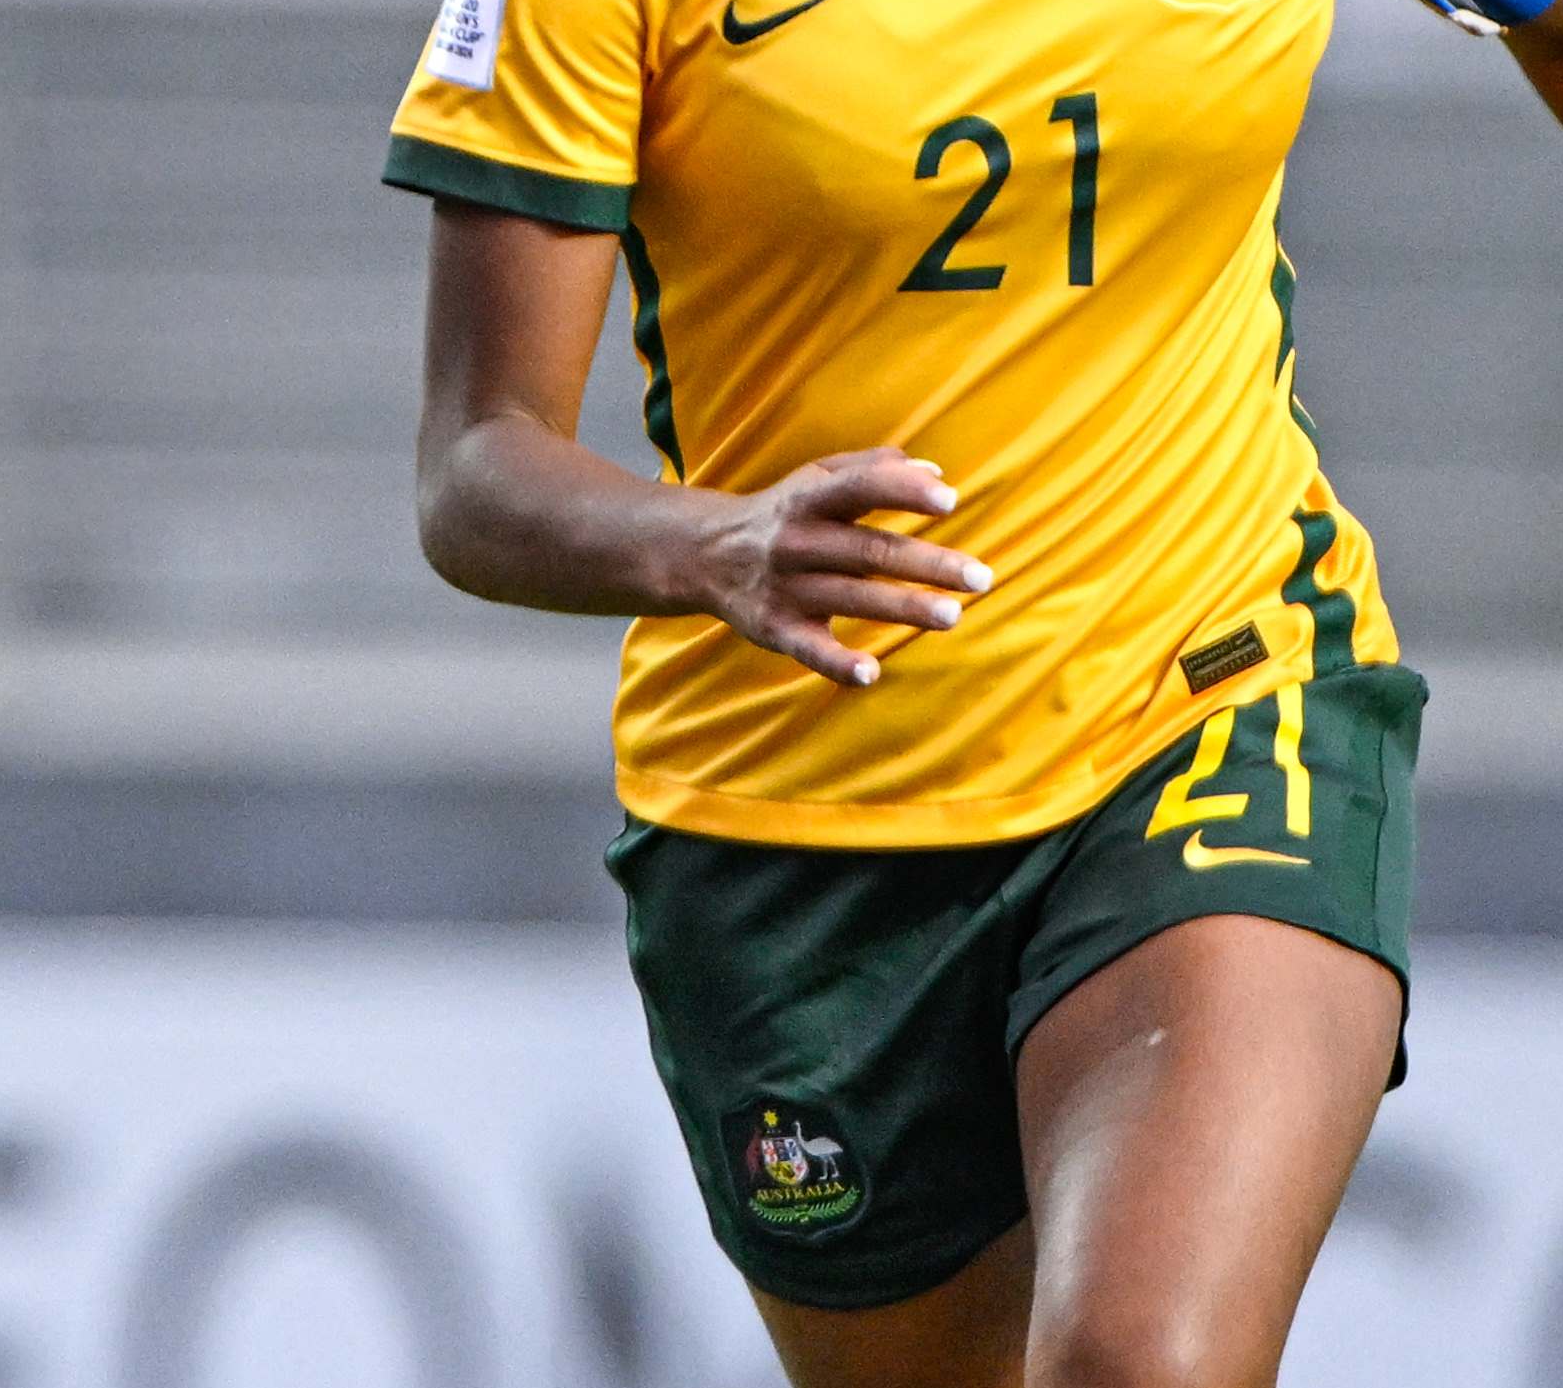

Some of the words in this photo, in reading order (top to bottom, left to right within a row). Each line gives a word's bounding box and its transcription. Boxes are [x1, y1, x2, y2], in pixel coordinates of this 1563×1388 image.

[897, 91, 1104, 293] 21
[1144, 680, 1311, 842] 21
[756, 1180, 846, 1204] AUSTRALIA
